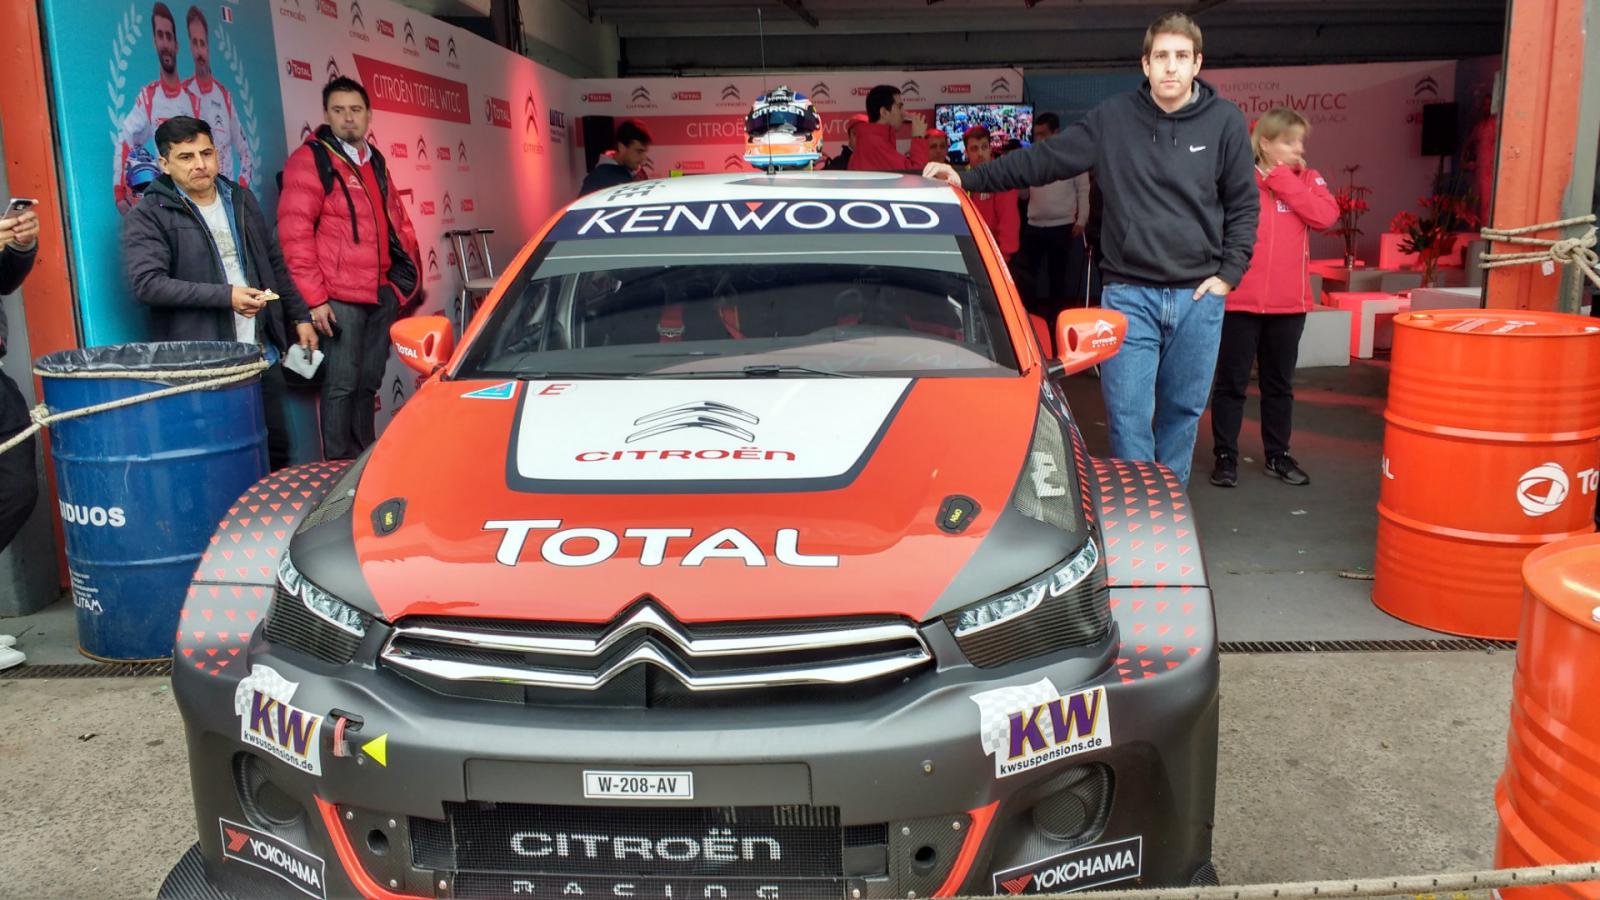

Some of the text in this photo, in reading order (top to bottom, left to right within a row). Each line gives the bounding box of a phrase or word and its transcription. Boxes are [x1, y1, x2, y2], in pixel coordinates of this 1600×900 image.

[373, 73, 462, 113] CITROËN TOTAL WTCC
[686, 117, 744, 137] CITROË
[577, 202, 940, 235] KENWOOD
[395, 342, 418, 359] TOTAL
[539, 383, 572, 396] E
[481, 518, 839, 568] TOTAL
[249, 689, 319, 759] KW
[1008, 688, 1103, 761] KW
[244, 731, 314, 771] kwsuspensions.de
[1000, 737, 1103, 775] kwsuspensions.de
[598, 776, 677, 794] W-208-AV
[249, 838, 320, 889] YOKOHAMA
[1033, 850, 1135, 891] YOKOHAMA
